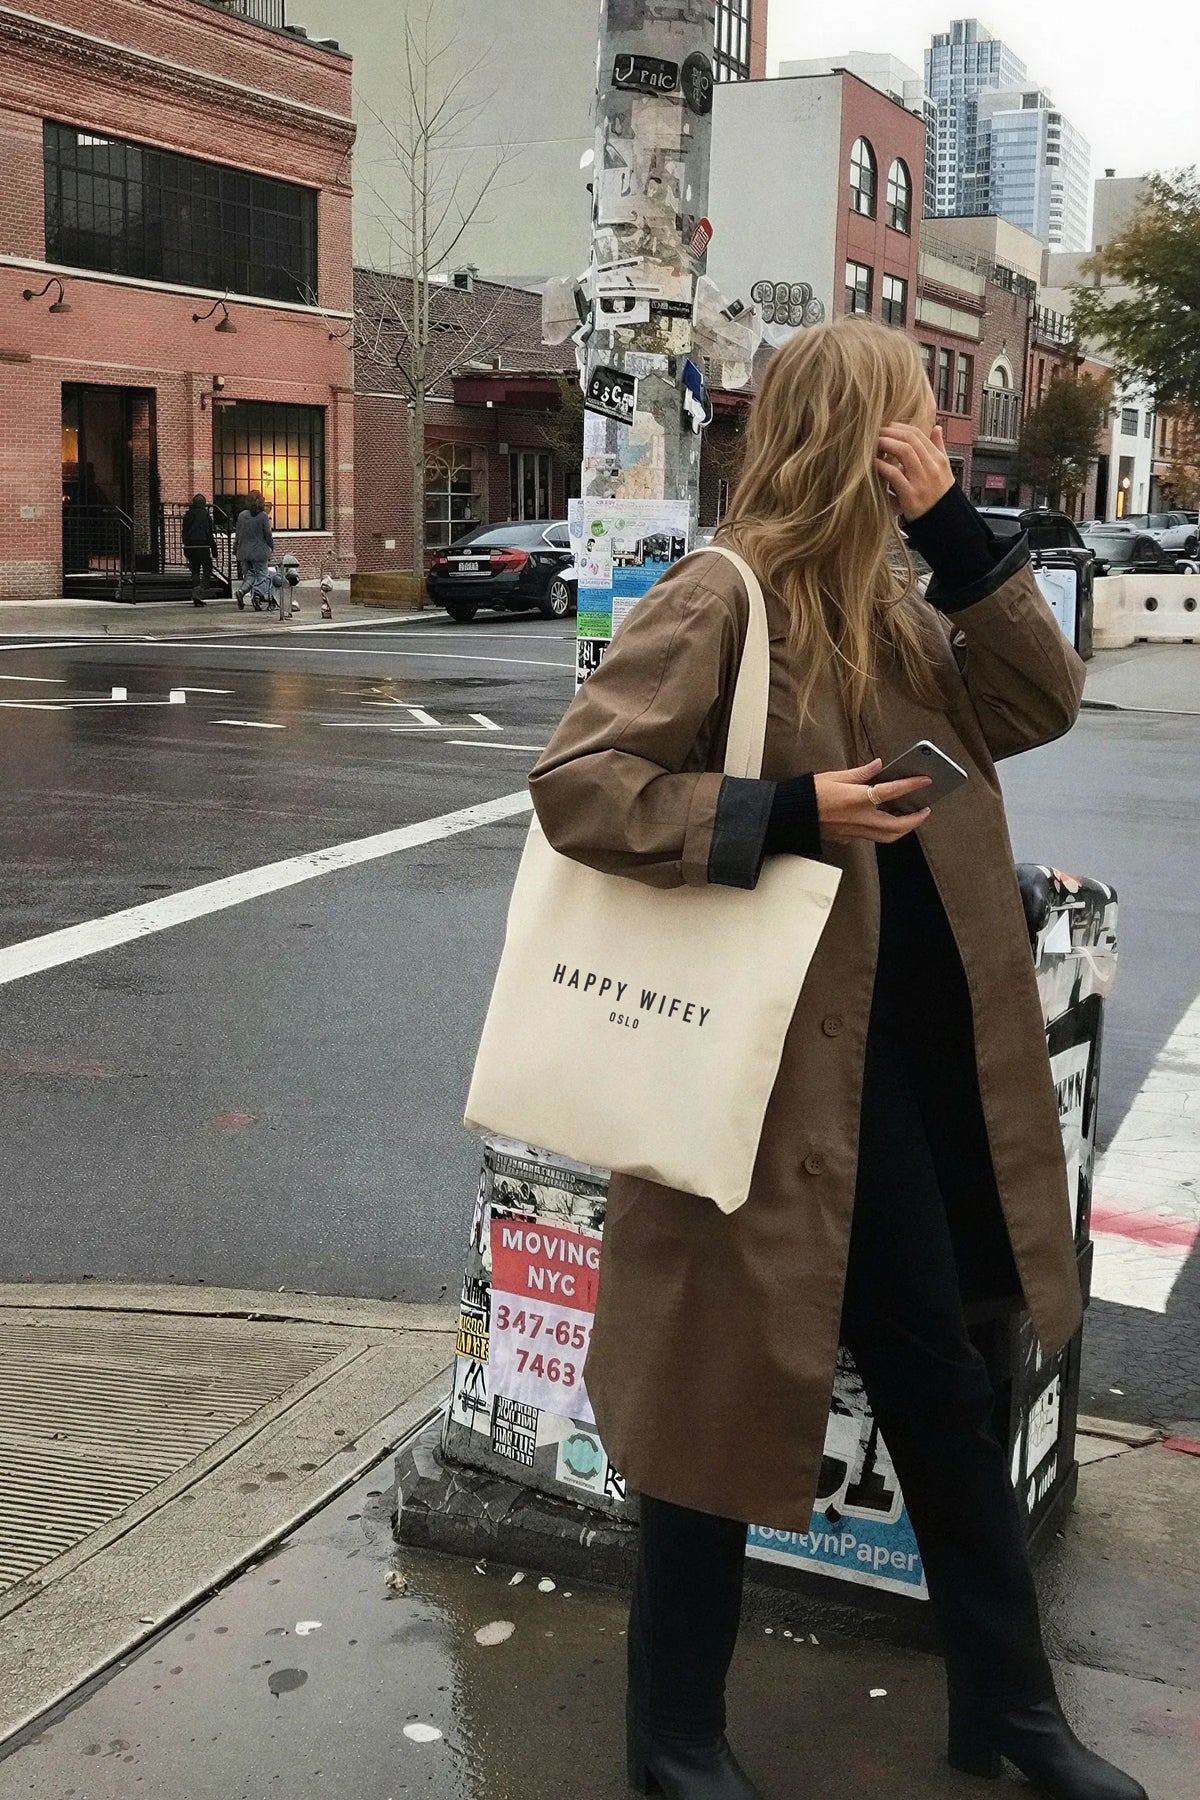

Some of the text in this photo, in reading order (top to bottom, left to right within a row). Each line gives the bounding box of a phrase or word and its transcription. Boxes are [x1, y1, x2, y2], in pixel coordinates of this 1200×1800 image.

[552, 963, 711, 1027] HAPPY WIFEY
[608, 1011, 640, 1029] OSLO
[502, 1227, 600, 1270] MOVING
[527, 1264, 576, 1297] NYC
[496, 1304, 593, 1350] 347-65
[516, 1347, 576, 1387] 7463
